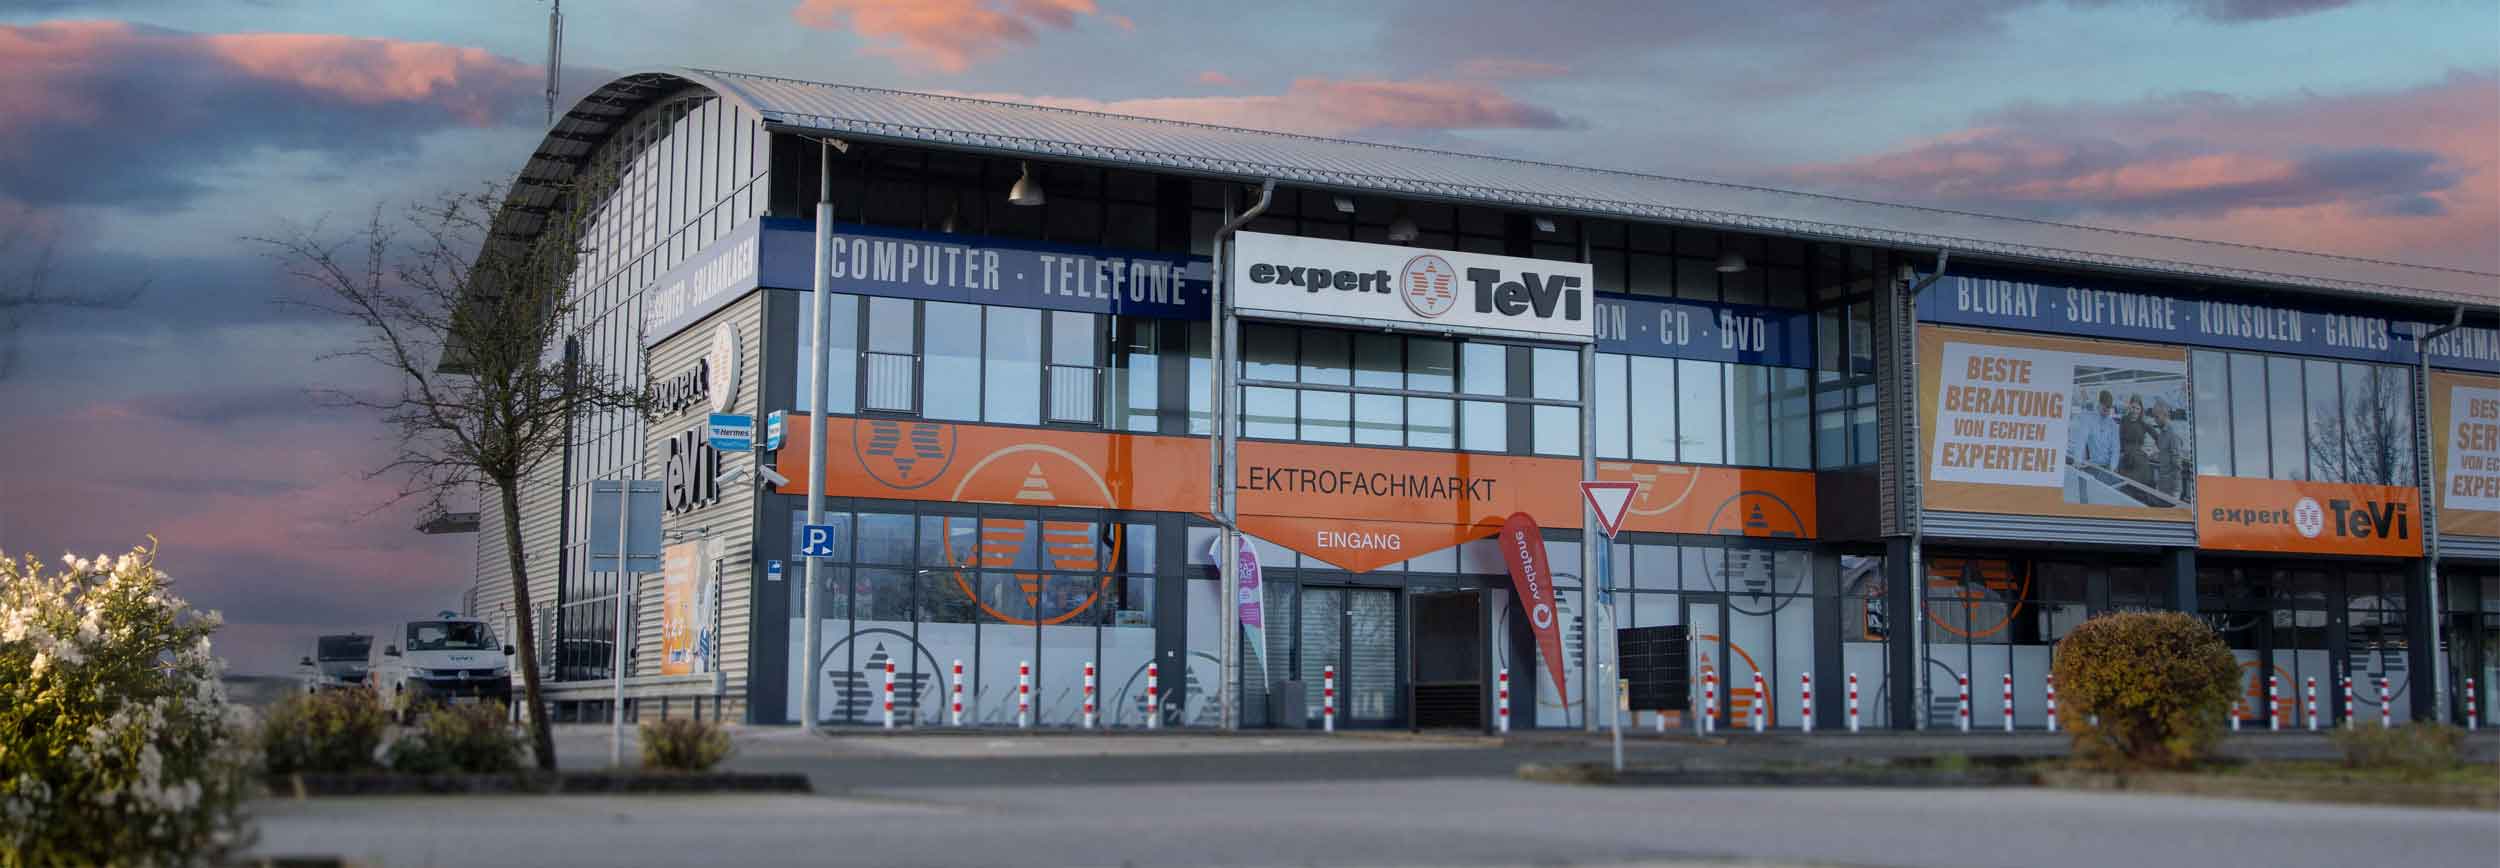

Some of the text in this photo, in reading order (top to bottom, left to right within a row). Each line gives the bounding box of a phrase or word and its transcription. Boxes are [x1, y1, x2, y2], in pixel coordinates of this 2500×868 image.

[831, 236, 1186, 305] COMPUTER TELEFONE
[1248, 260, 1582, 321] expert TeVi
[1660, 309, 1689, 345] CD
[1720, 308, 1766, 352] DVD
[1957, 276, 2039, 317] BLURAY
[2066, 287, 2177, 330] SOFTWARE
[2200, 300, 2303, 342] KONSOLEN
[2325, 313, 2389, 350] GAMES
[1967, 355, 2033, 385] BESTE
[1944, 384, 2065, 419] BERATUNG
[720, 428, 749, 437] Hermes
[1953, 418, 2046, 442] VON ECHTEN
[1942, 442, 2057, 473] EXPERTEN!
[1218, 464, 1497, 501] EKTROFACHMARKT
[2212, 500, 2408, 539] expert TeVi
[809, 528, 827, 551] P
[1317, 531, 1401, 550] EINGANG
